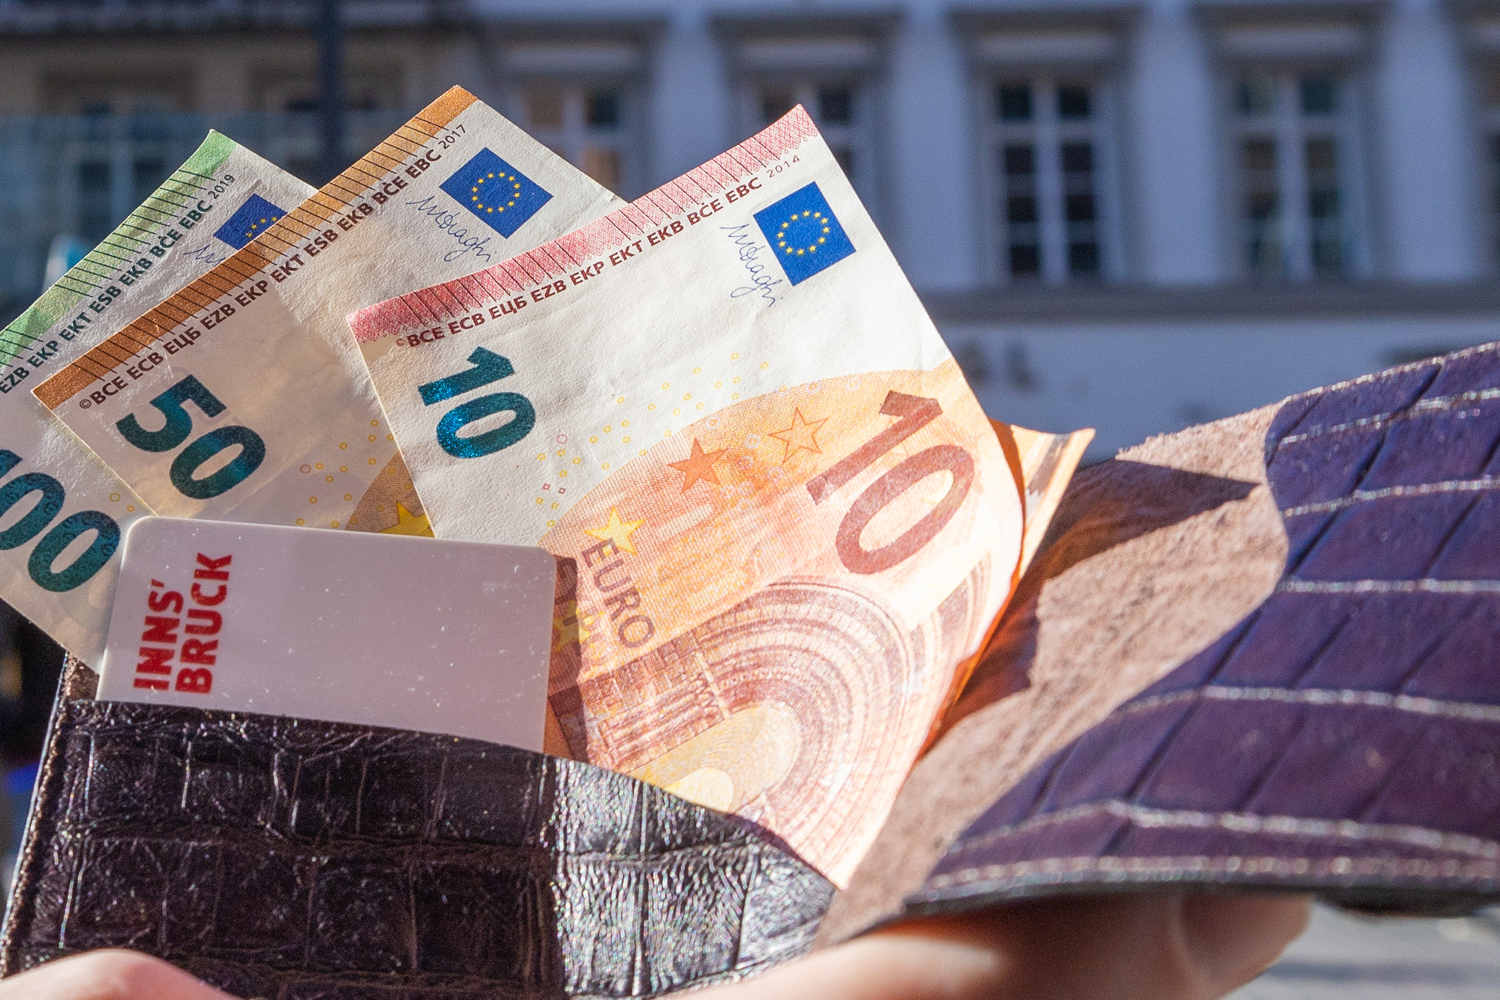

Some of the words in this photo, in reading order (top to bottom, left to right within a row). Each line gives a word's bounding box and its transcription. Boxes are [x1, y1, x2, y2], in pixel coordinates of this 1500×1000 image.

[27, 340, 59, 368] EKP
[58, 312, 92, 342] EKT
[89, 285, 122, 314] ESB
[118, 257, 153, 287] EKB
[178, 200, 213, 230] EBC
[207, 174, 235, 199] 2019
[126, 352, 164, 380] ECB
[200, 303, 237, 331] EZB
[234, 279, 269, 308] EKP
[269, 254, 306, 284] EKT
[303, 228, 339, 258] ESB
[336, 202, 374, 232] EKB
[405, 149, 442, 179] EBC
[438, 124, 467, 150] 2017
[447, 312, 485, 335] ECB
[530, 279, 567, 303] EZB
[569, 260, 605, 286] EKP
[608, 240, 644, 267] EKT
[646, 220, 684, 248] EKB
[724, 177, 763, 205] EBC
[766, 154, 800, 178] 2014
[115, 374, 266, 500] 50
[417, 346, 536, 459] 10
[805, 390, 975, 575] 10
[132, 578, 184, 691] INNS'
[174, 552, 233, 695] BRUCK
[581, 537, 655, 648] EURO
